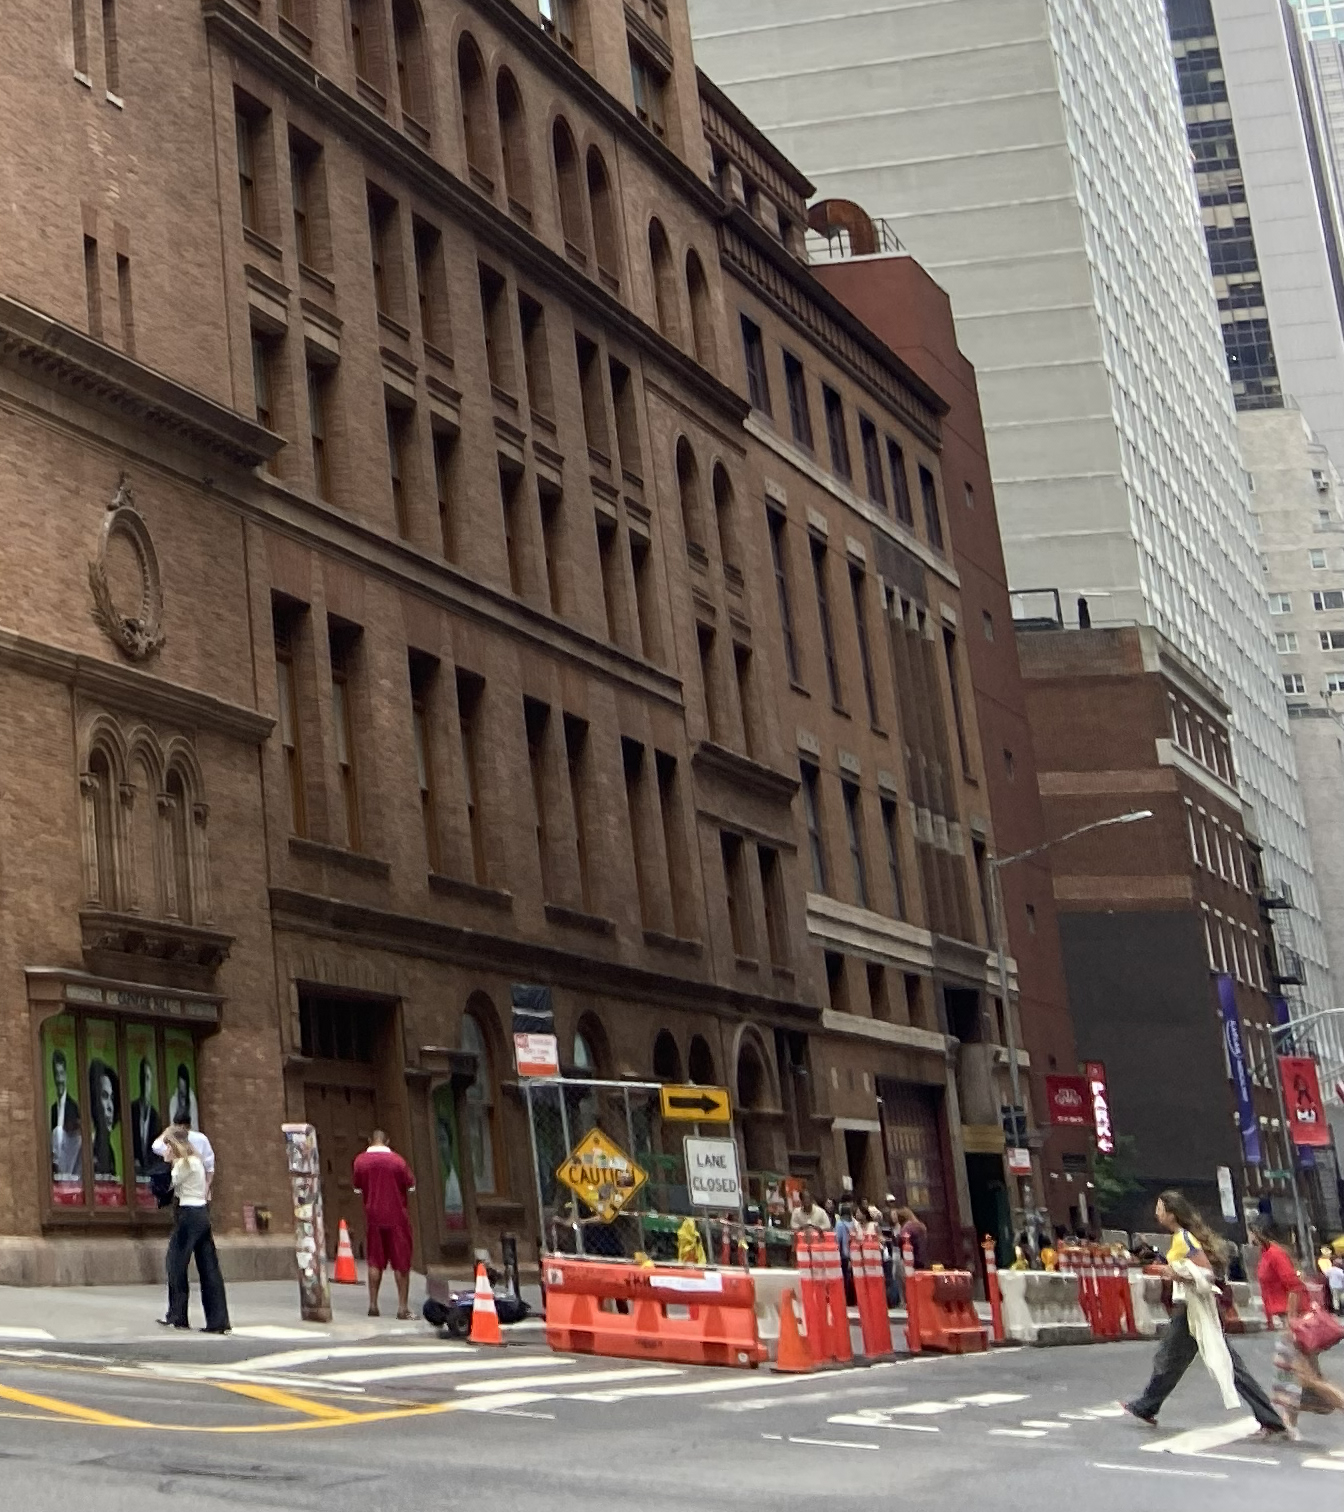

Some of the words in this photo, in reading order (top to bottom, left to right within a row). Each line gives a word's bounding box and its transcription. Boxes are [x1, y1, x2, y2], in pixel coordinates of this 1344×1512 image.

[696, 1153, 728, 1169] LANE
[568, 1167, 635, 1188] CAUTI
[692, 1176, 738, 1193] CLOSED
